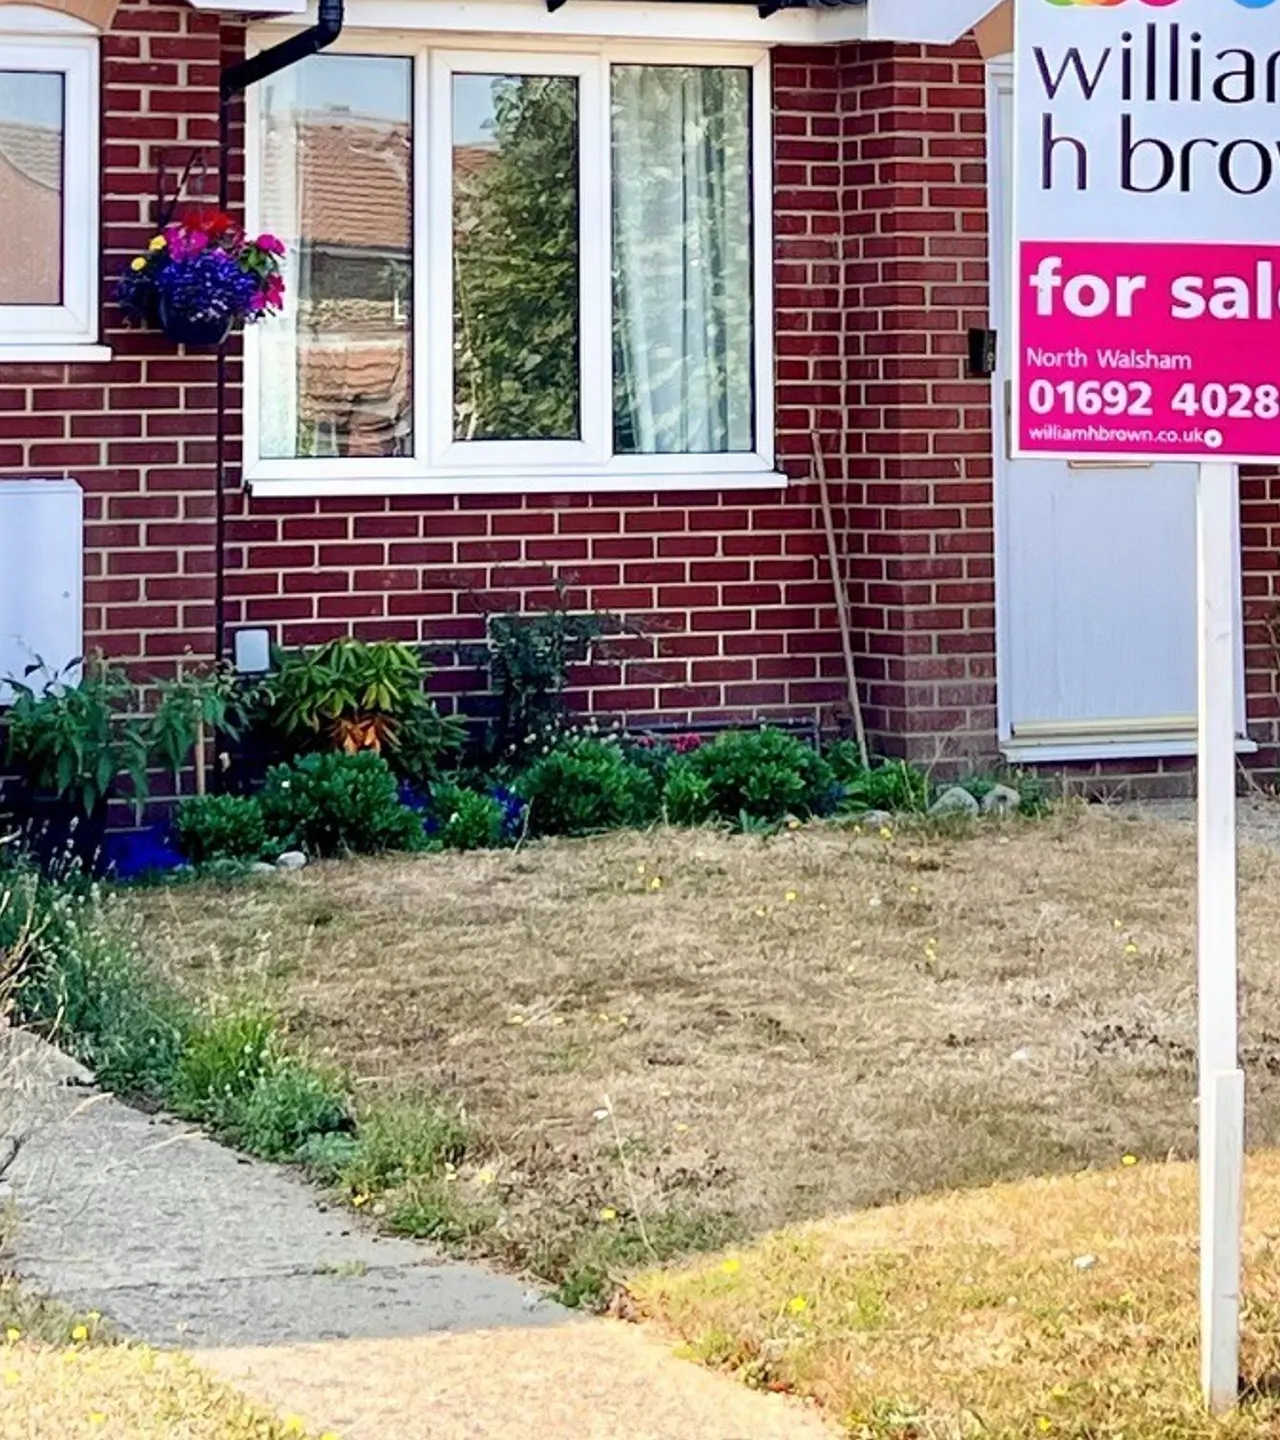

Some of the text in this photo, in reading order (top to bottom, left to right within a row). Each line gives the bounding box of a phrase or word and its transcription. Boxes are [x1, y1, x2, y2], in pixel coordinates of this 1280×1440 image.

[1042, 112, 1087, 190] h
[1029, 256, 1147, 318] for
[1026, 347, 1193, 370] North Walsham
[1028, 379, 1153, 416] 01692
[1028, 424, 1204, 444] williamhbrown.co.uk
